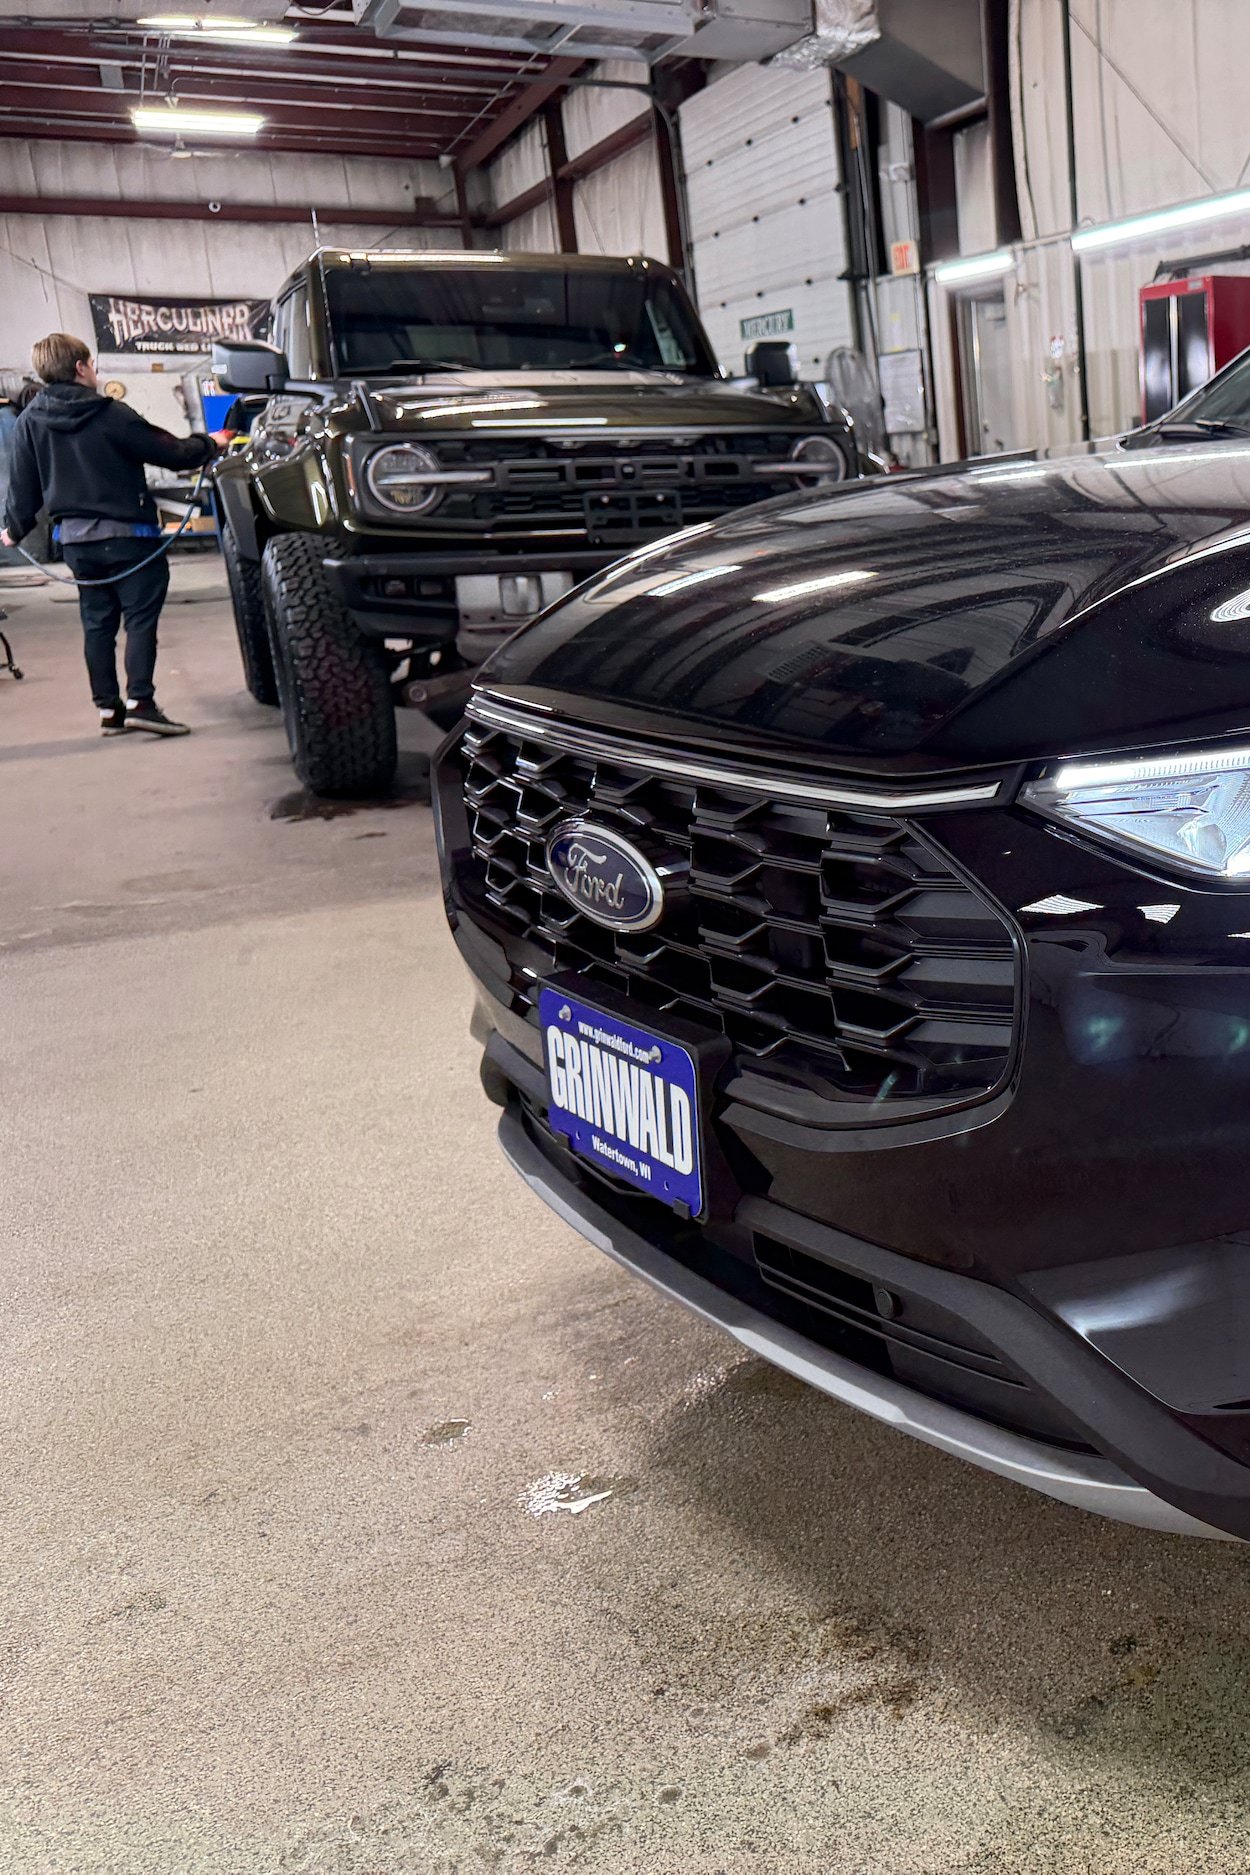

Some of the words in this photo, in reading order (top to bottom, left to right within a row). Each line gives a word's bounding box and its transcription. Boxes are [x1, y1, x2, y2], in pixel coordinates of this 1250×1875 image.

[108, 297, 252, 348] HERCULINER
[135, 341, 174, 351] TRUCK
[564, 843, 624, 909] Ford
[546, 1025, 693, 1176] GRINWALD
[591, 1134, 639, 1176] Watertown,
[639, 1161, 652, 1181] WI
